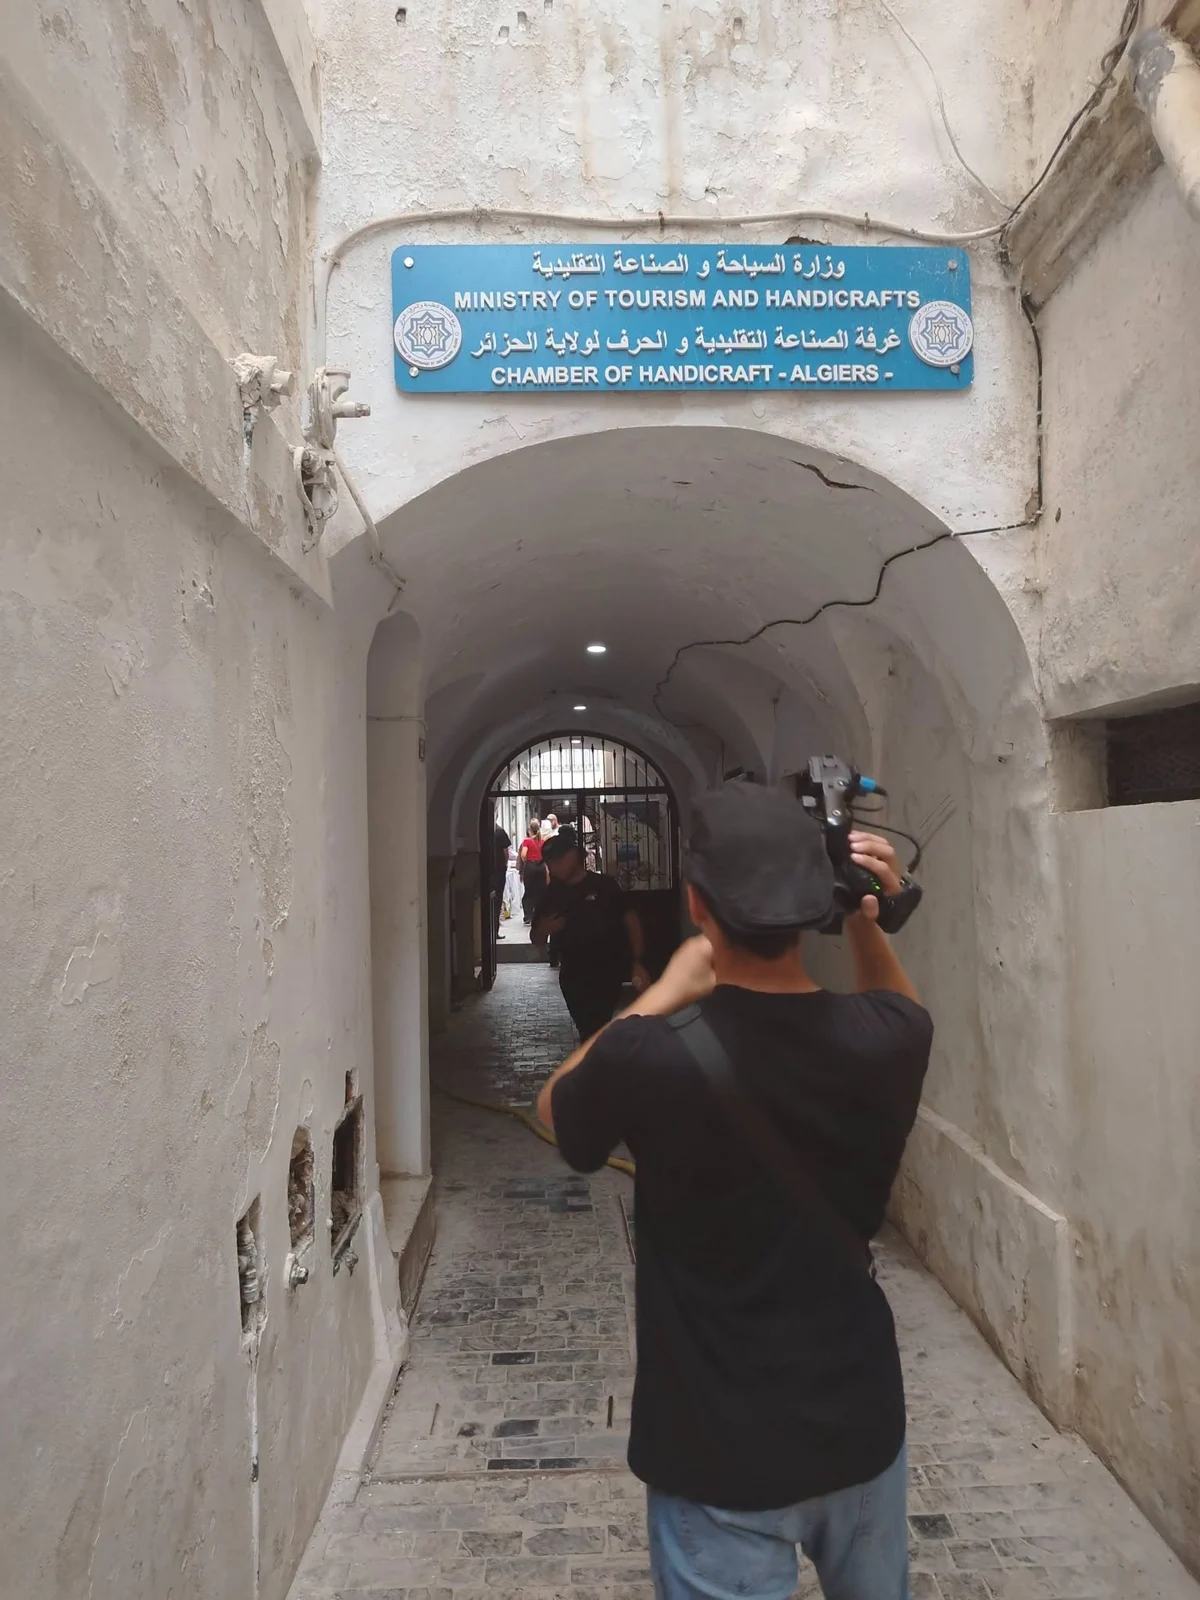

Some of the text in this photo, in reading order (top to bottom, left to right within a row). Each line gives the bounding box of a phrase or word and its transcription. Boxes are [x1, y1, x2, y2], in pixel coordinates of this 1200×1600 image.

[532, 250, 845, 280] وزارة السياحة و الصناعة التقليدية
[454, 289, 921, 309] MINISTRY OF TOURISM AND HANDICRAFTS
[545, 328, 600, 356] لولاية
[607, 329, 667, 355] الحرف
[676, 337, 688, 354] و
[695, 327, 767, 355] التقليدية
[774, 326, 848, 350] الصناعة
[855, 327, 901, 354] غرفة
[491, 366, 599, 386] CHAMBER
[605, 365, 633, 383] OF
[639, 365, 773, 383] HANDICRAFT
